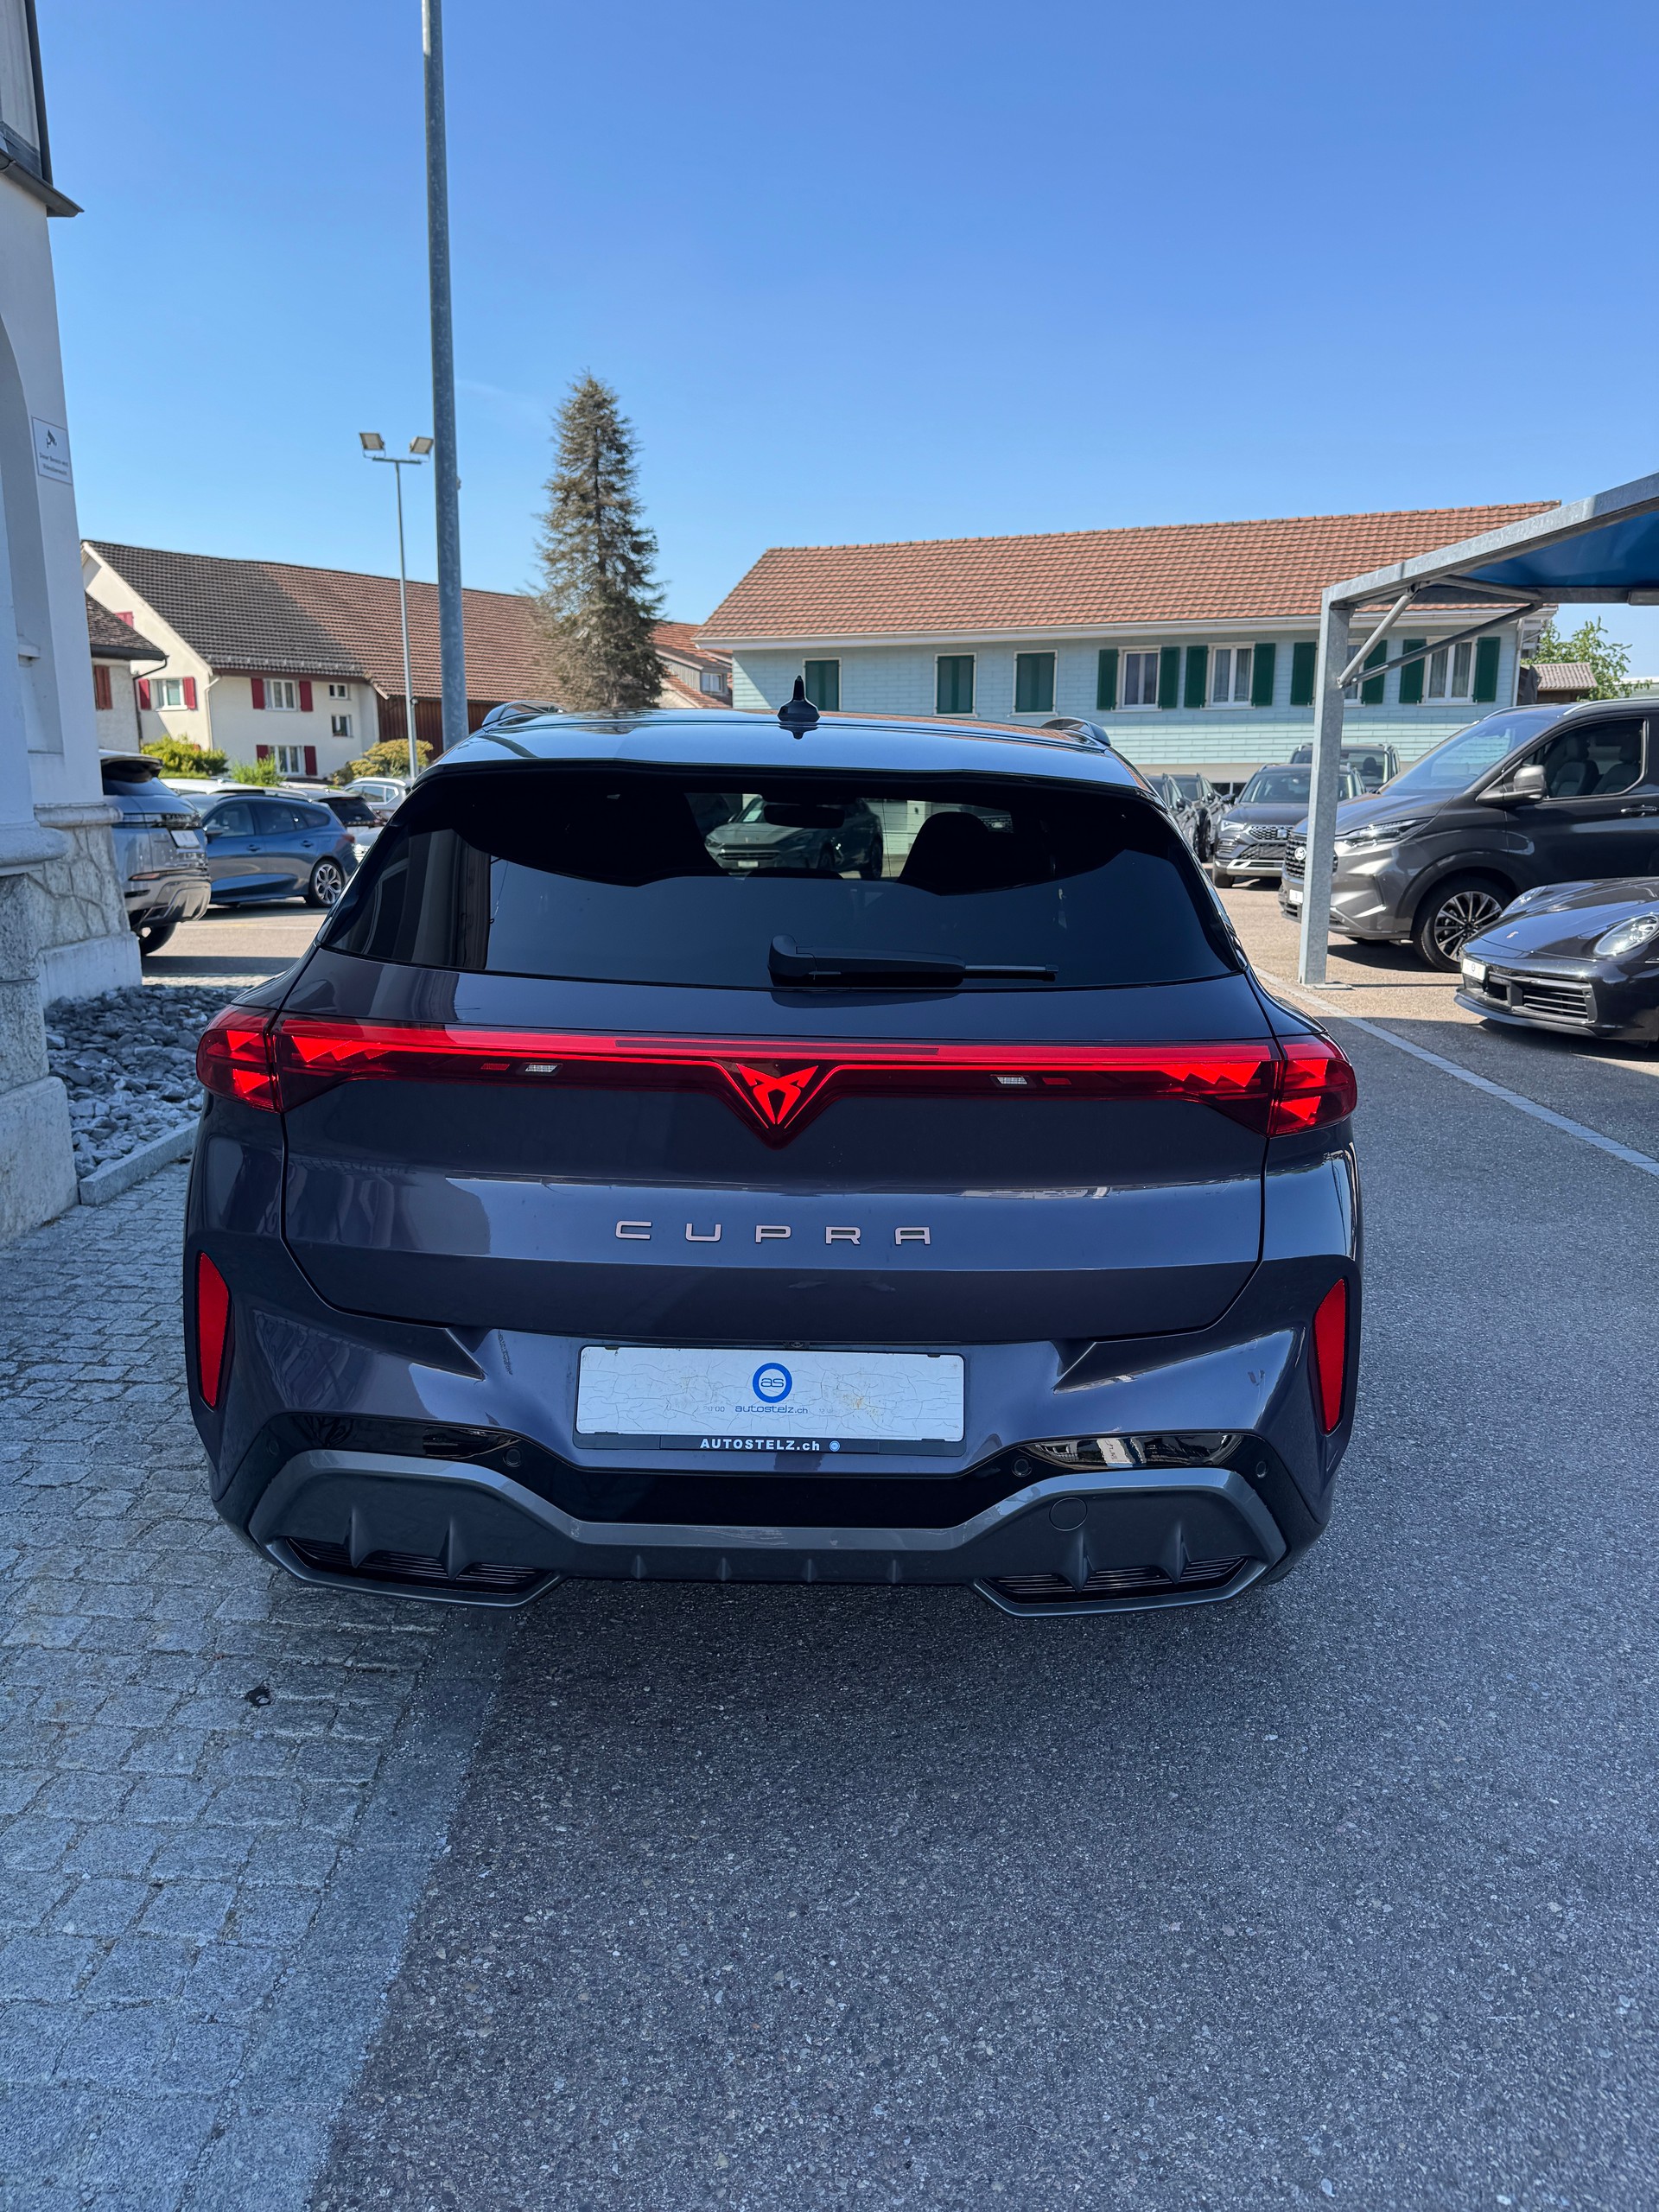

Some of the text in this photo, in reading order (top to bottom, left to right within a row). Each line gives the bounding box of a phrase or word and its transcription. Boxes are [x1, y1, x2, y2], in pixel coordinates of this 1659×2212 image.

[615, 1219, 931, 1245] CUPRA
[734, 1404, 809, 1414] autostelz.ch
[700, 1438, 820, 1451] AUTOSTELZ.ch
